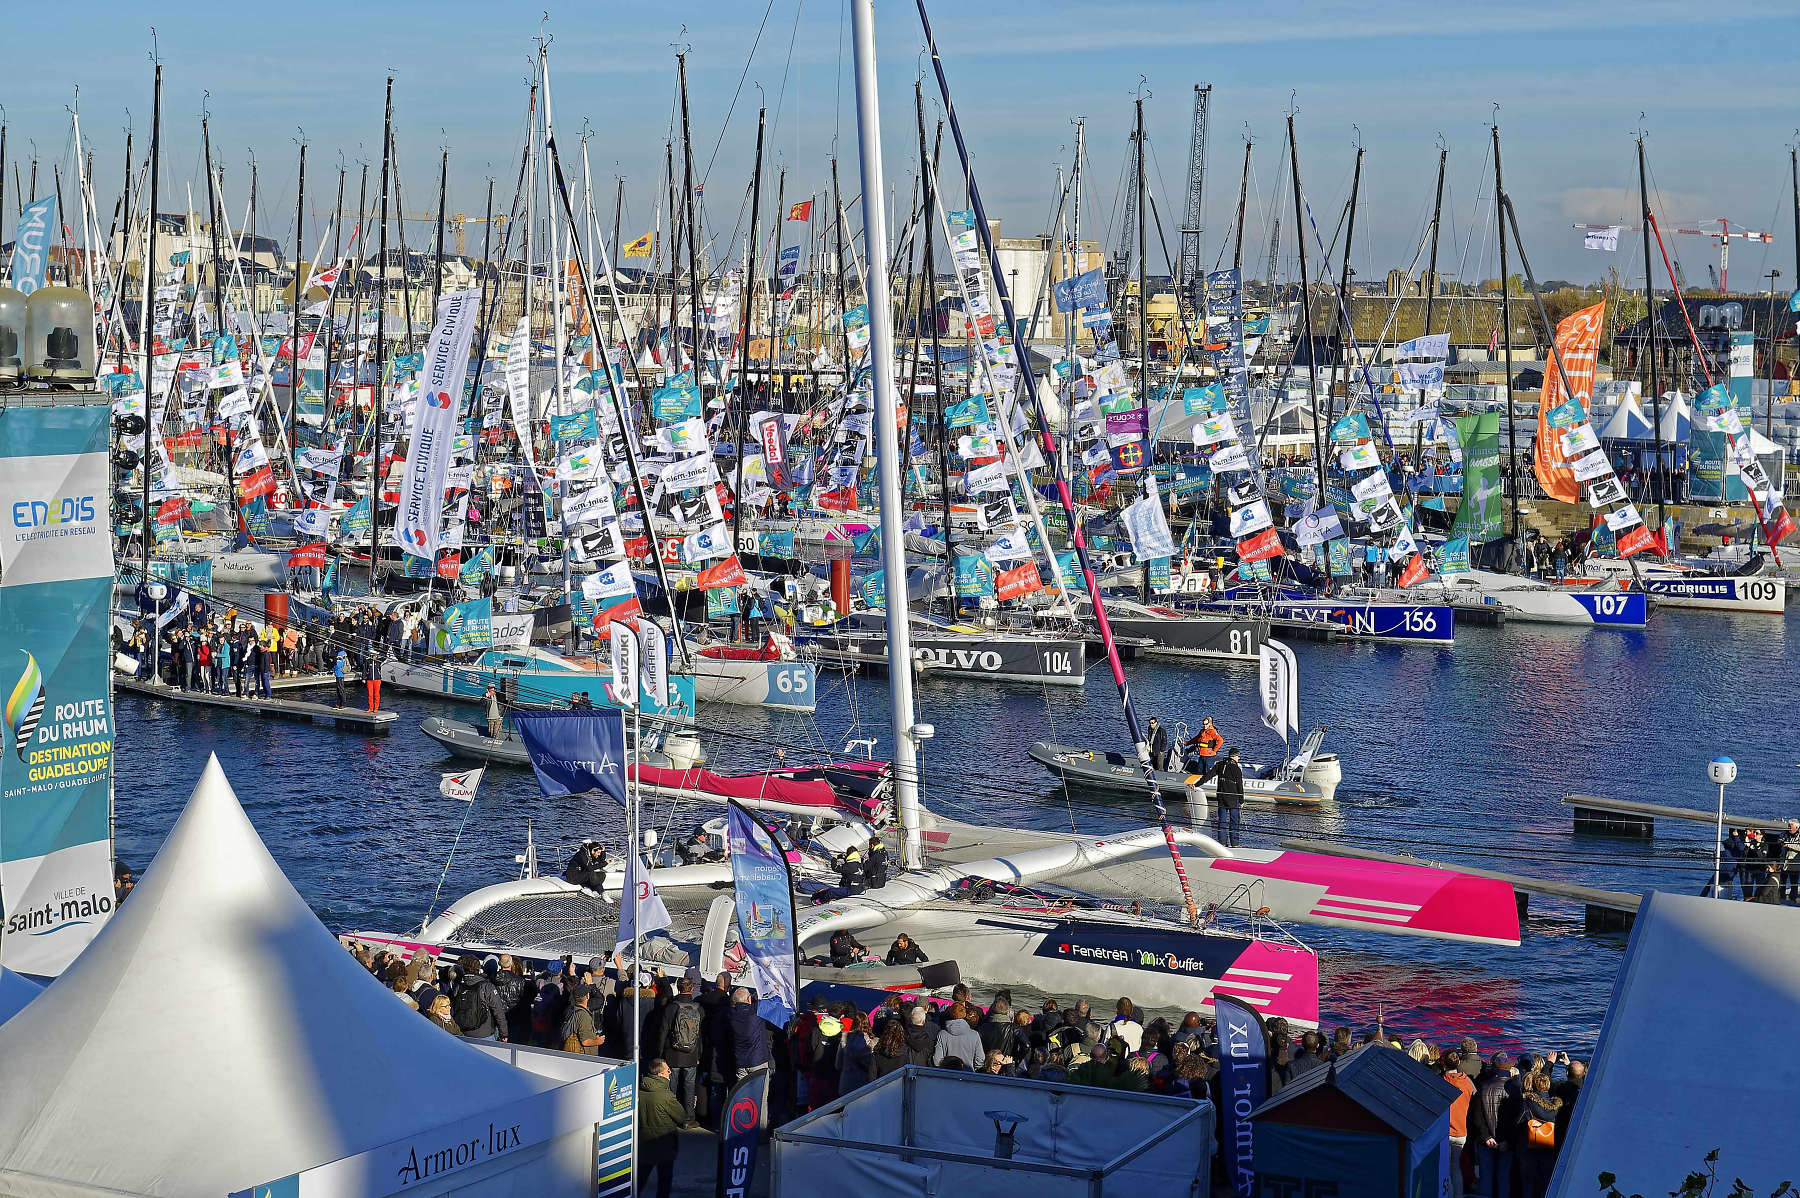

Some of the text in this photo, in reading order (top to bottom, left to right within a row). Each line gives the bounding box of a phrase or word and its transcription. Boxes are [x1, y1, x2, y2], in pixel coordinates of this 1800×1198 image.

[431, 294, 464, 386] SERVICE CIVIQUE
[765, 423, 779, 462] Veedol
[407, 427, 435, 524] SERVICE CIVIQUE
[1669, 584, 1728, 594] CORIOLIS
[1739, 582, 1776, 601] 109
[1593, 595, 1628, 616] 107
[1403, 610, 1437, 633] 156
[1229, 629, 1252, 655] 81
[620, 634, 629, 684] SUZUKI
[646, 627, 657, 684] HIGHFIELD
[1043, 651, 1072, 674] 104
[776, 669, 808, 694] 65
[1268, 657, 1279, 711] SUZUKI
[55, 698, 106, 721] ROUTE
[39, 717, 109, 744] DU RHUM
[30, 740, 112, 766] DESTINATION
[28, 756, 110, 782] GUADELOUPE
[4, 783, 53, 799] SAINT-MALO
[59, 772, 107, 789] GUADELOUPE
[53, 886, 87, 901] VILLE DE
[1136, 948, 1204, 972] Mix Buffet
